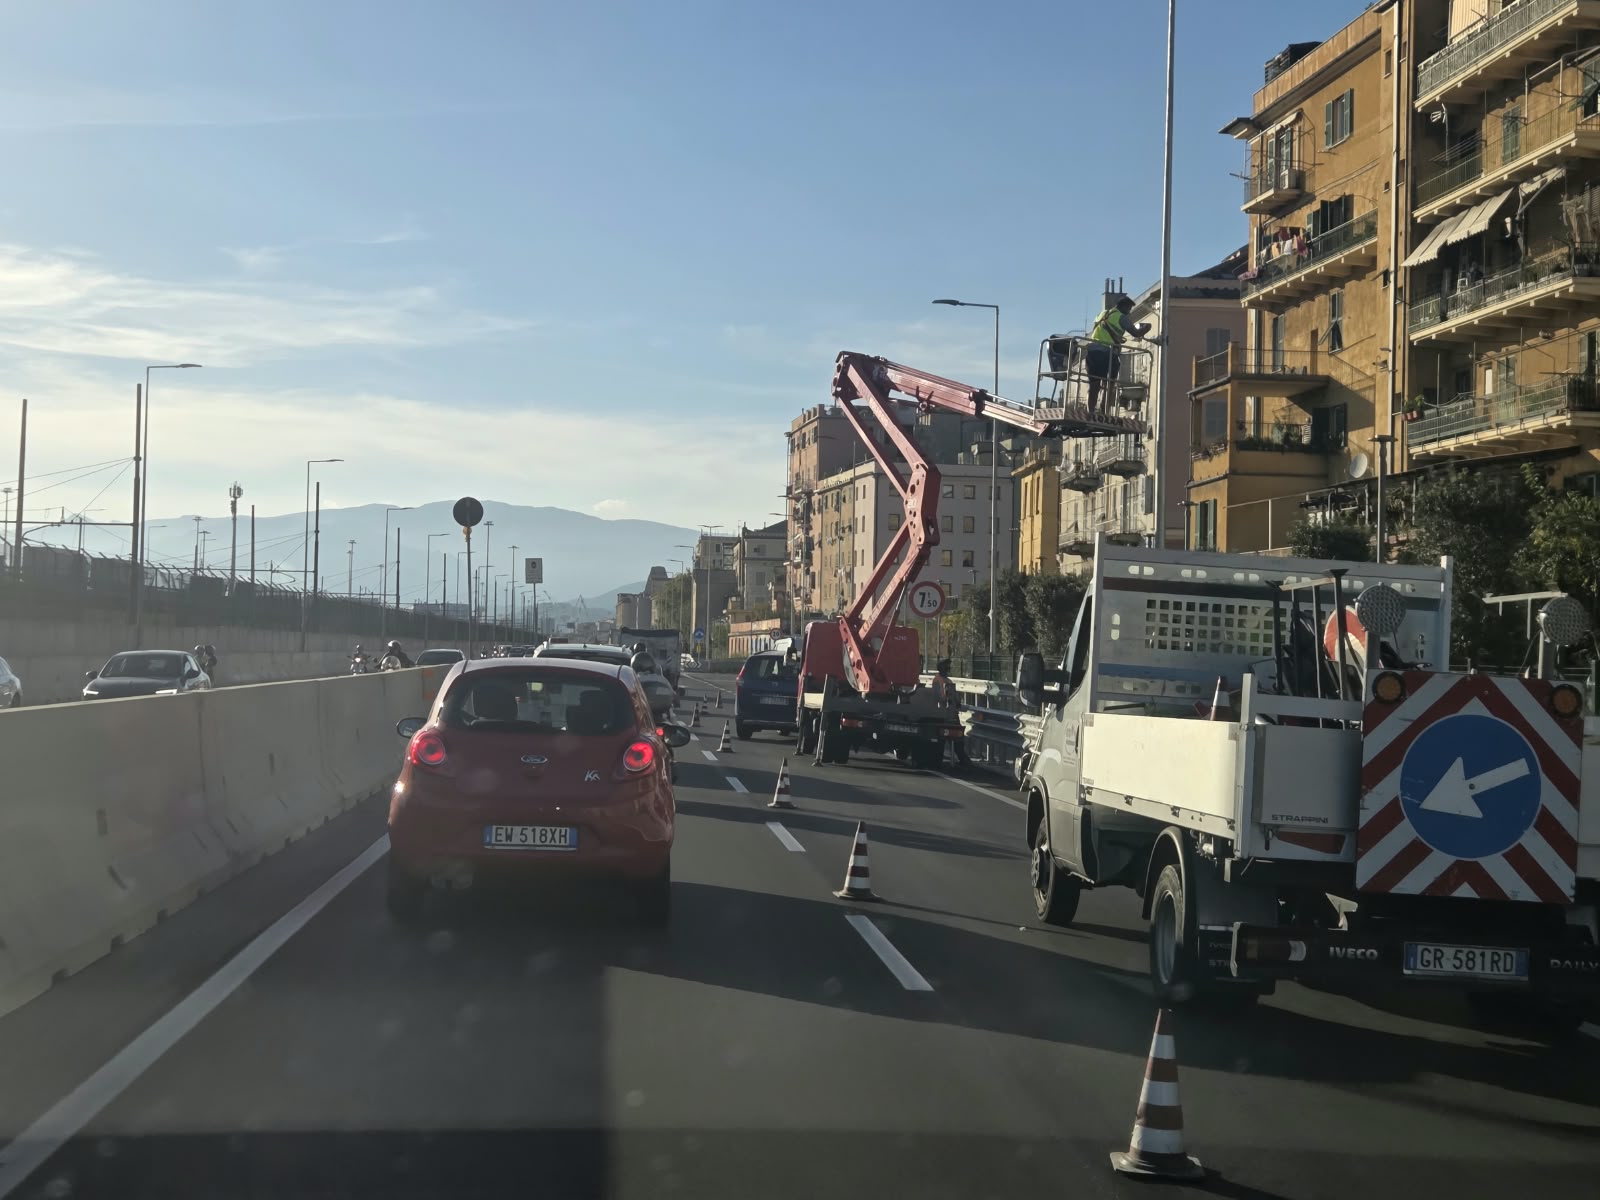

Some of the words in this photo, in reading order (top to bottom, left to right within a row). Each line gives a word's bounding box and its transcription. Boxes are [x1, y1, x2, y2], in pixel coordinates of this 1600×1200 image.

[1271, 814, 1328, 824] STRAPPINI
[495, 826, 513, 843] EW
[519, 827, 568, 844] 518XH
[1329, 946, 1378, 960] IVECO
[1420, 947, 1444, 969] GR
[1452, 949, 1514, 973] 581RD
